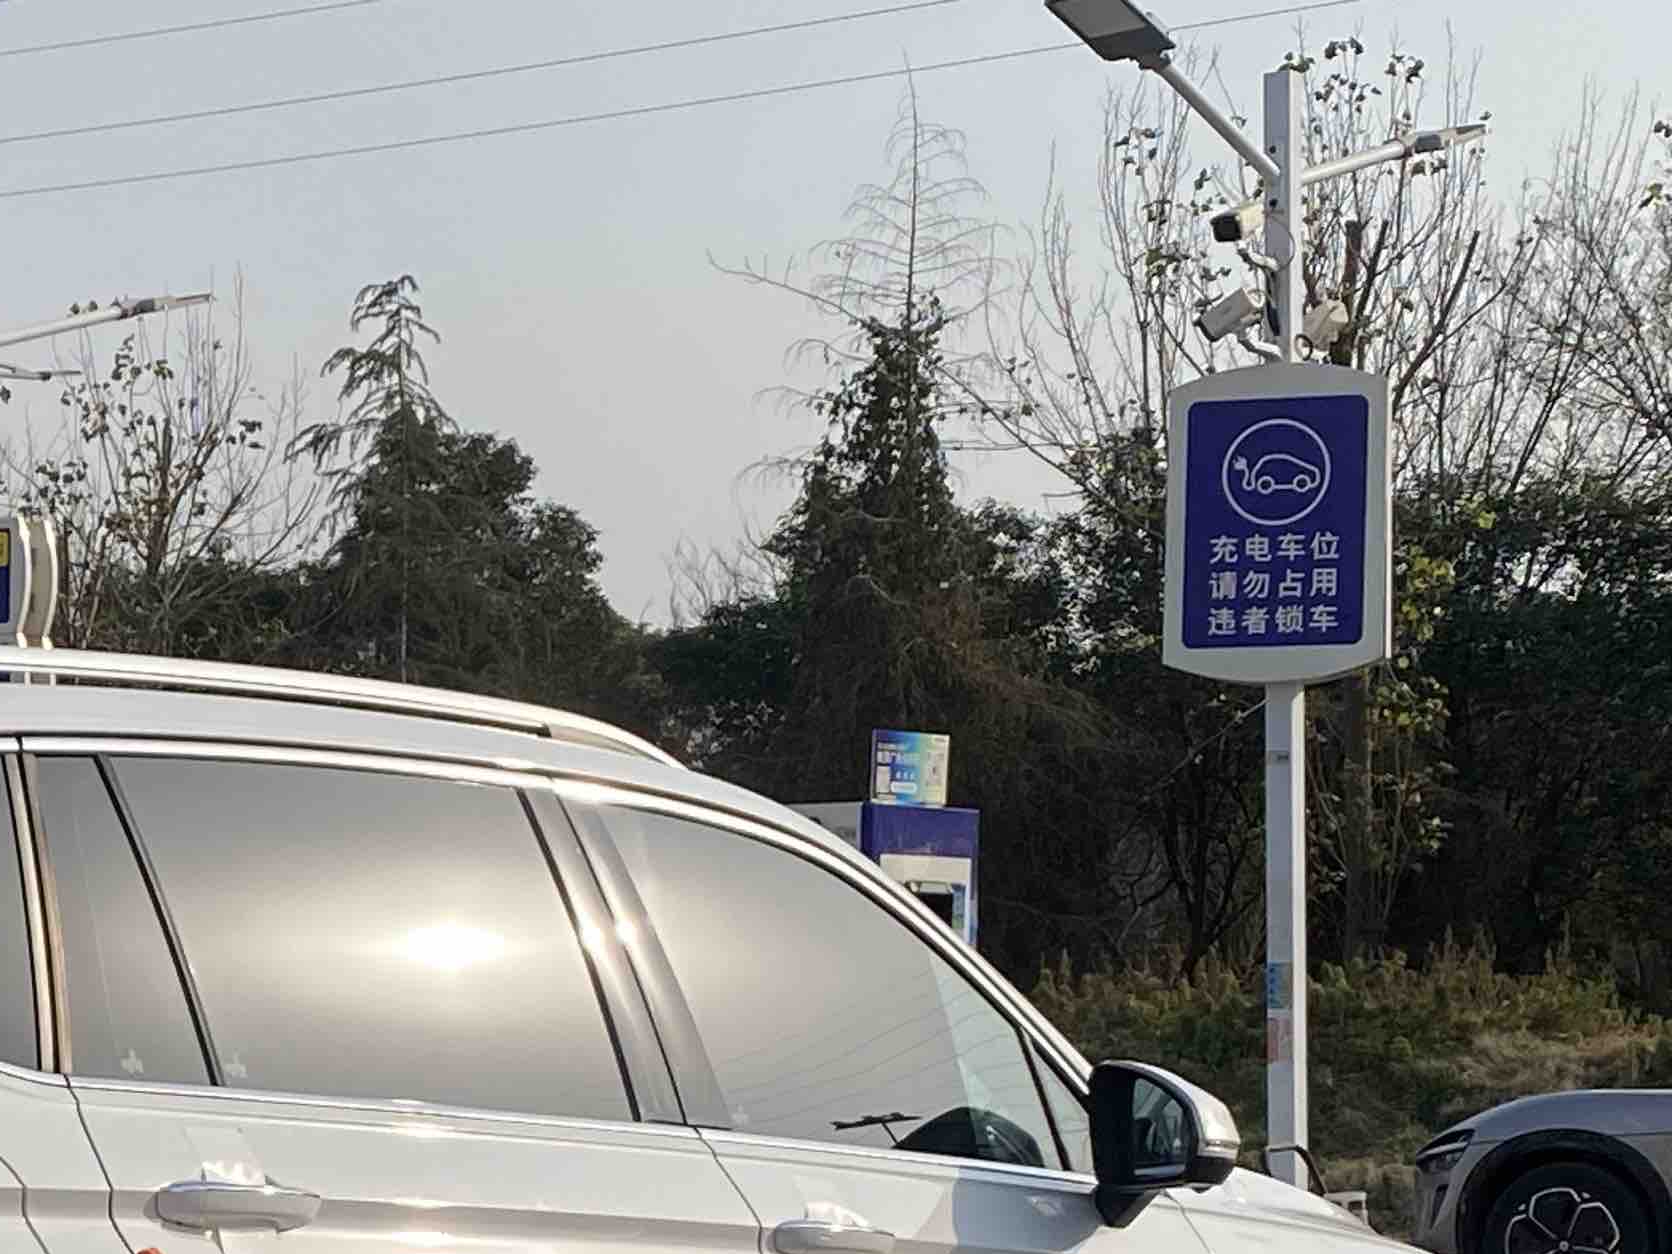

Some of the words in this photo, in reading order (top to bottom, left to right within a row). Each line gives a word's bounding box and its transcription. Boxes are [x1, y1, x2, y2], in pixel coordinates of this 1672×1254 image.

[1209, 532, 1340, 564] 充电车位
[1208, 568, 1338, 599] 请勿占用
[1207, 605, 1339, 636] 违者锁车
